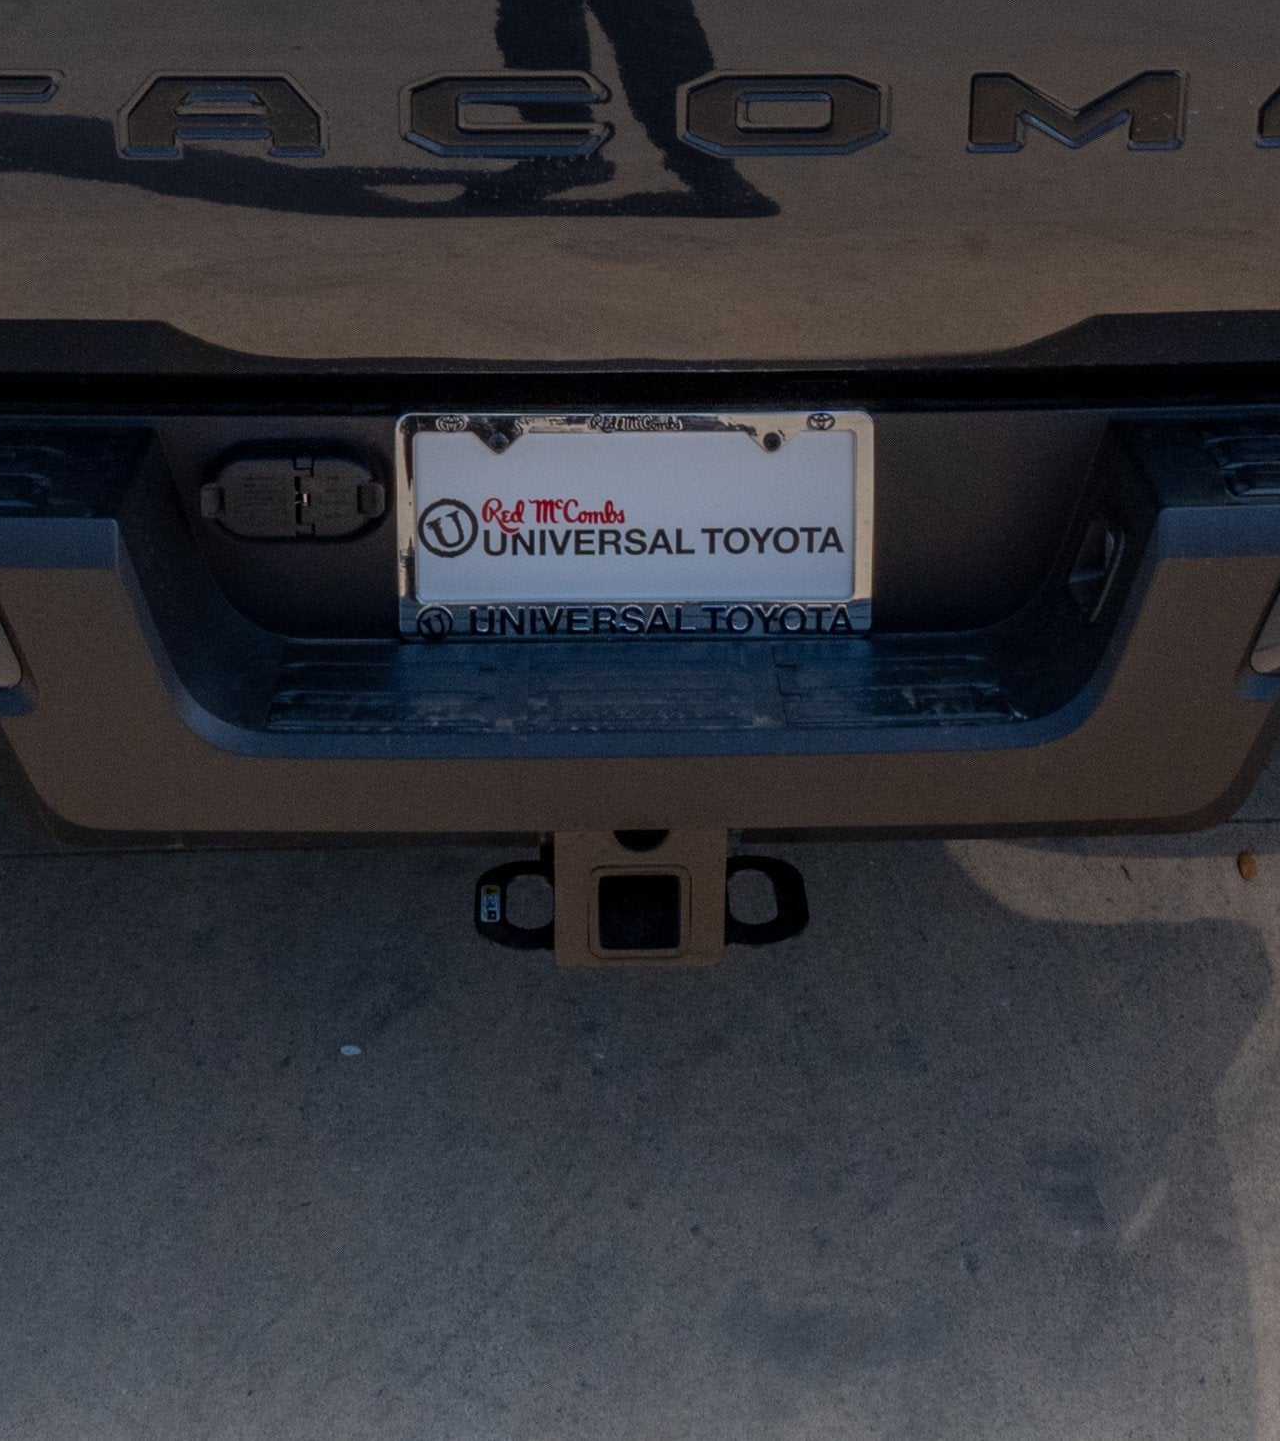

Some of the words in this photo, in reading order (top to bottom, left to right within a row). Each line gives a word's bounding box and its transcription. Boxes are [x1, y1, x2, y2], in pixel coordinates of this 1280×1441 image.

[481, 497, 525, 534] Red
[528, 498, 625, 524] McCombs
[483, 528, 695, 556] UNIVERSAL
[701, 526, 844, 555] TOYOTA
[468, 604, 697, 636] UNIVERSAL
[701, 603, 855, 635] TOYOTA
